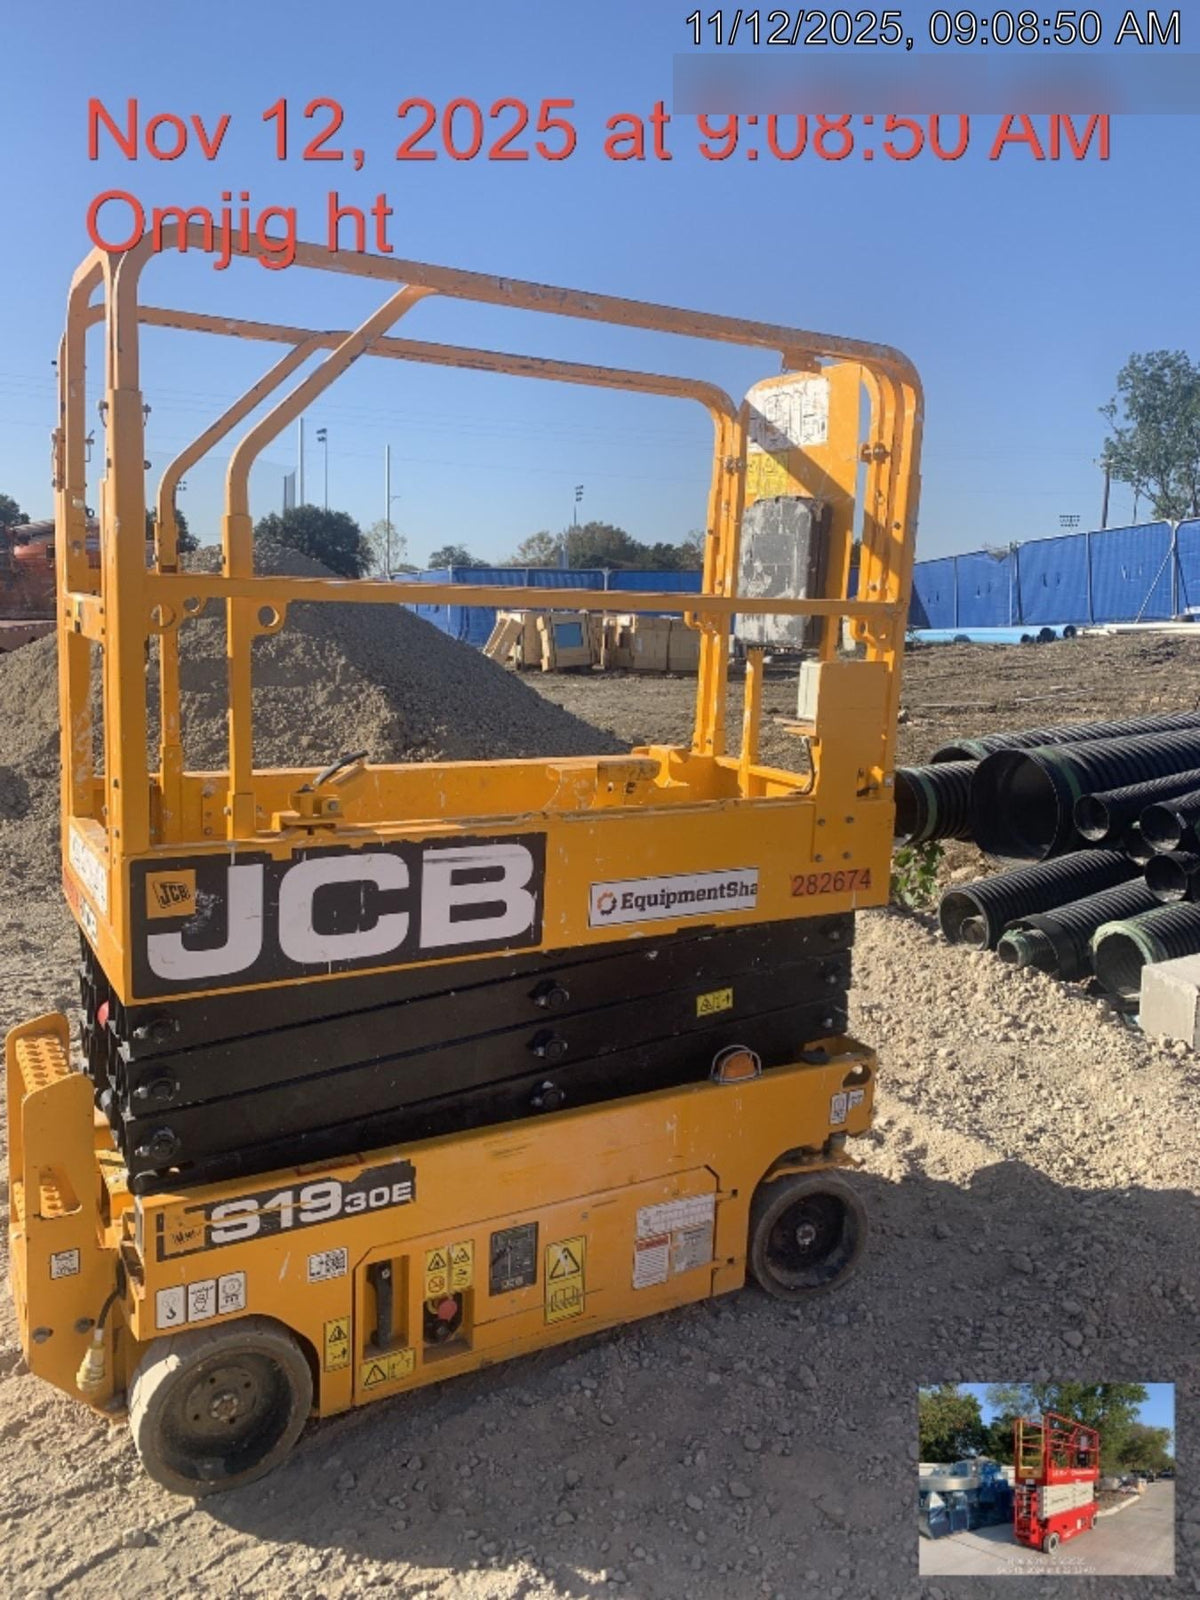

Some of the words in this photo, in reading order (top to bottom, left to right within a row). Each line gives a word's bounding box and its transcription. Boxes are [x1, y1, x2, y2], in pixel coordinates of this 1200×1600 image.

[156, 879, 191, 907] JCB
[790, 868, 872, 898] 282674
[147, 843, 537, 982] JCB
